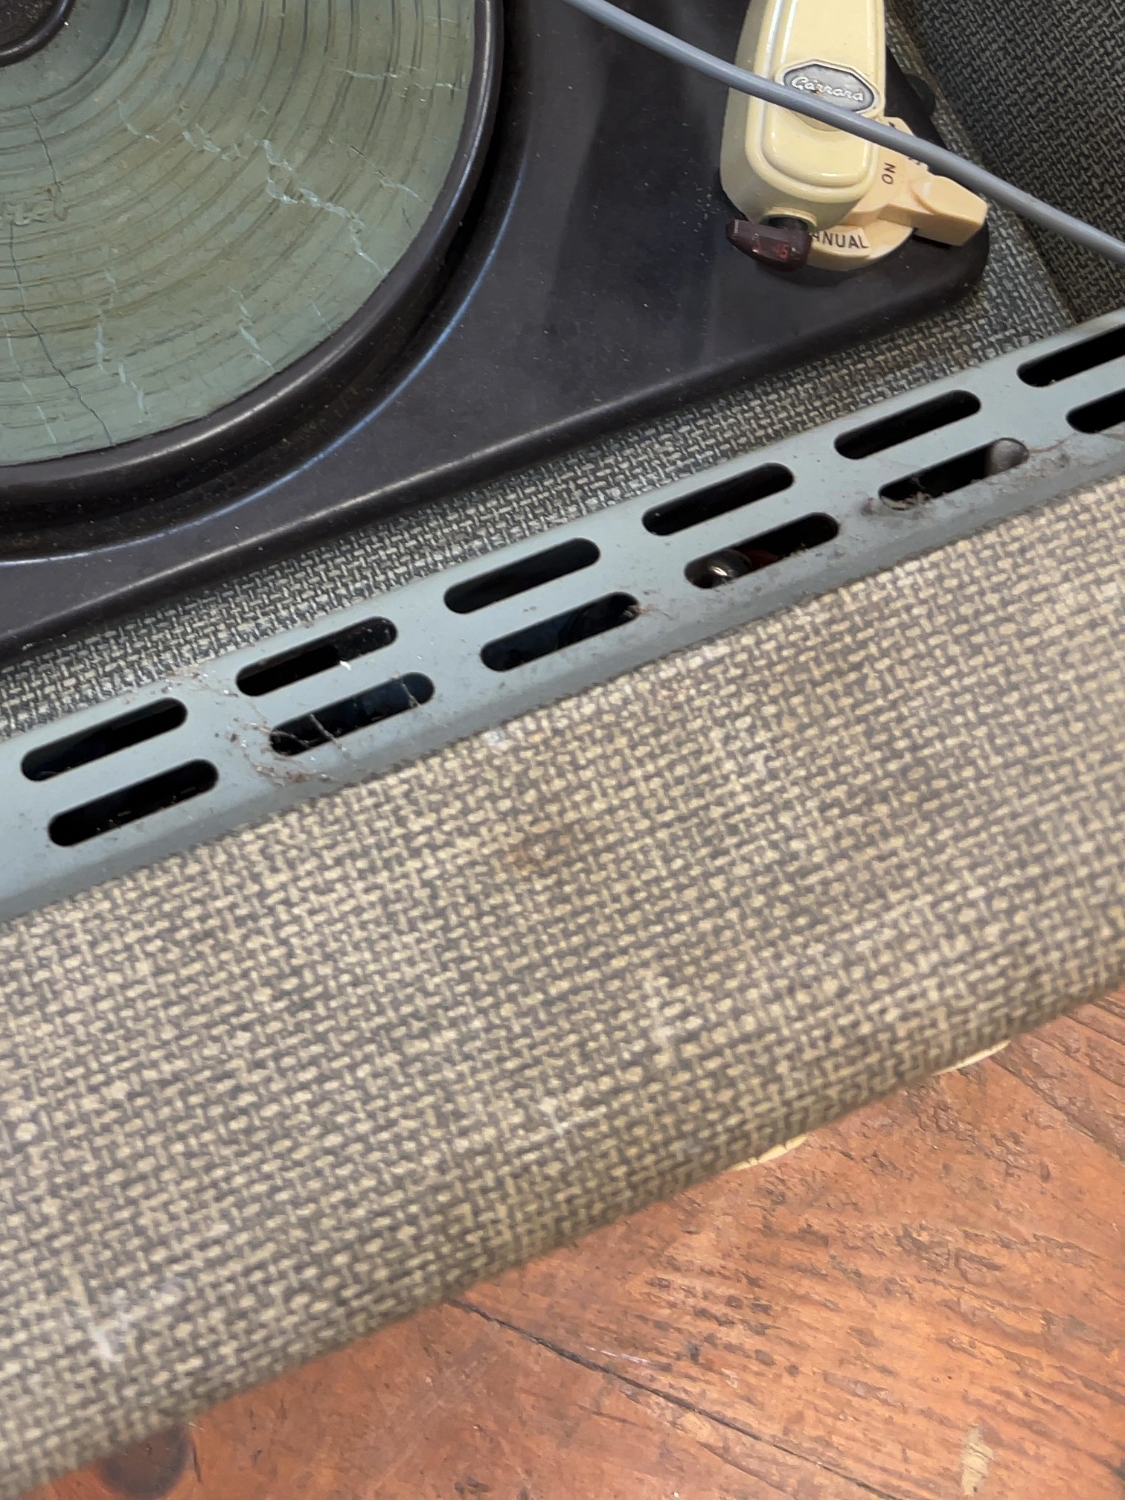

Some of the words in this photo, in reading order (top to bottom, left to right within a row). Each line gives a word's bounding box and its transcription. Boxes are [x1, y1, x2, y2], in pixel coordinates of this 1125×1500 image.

[790, 76, 865, 102] Garrard
[881, 162, 897, 186] ON
[809, 230, 870, 249] ANUAL
